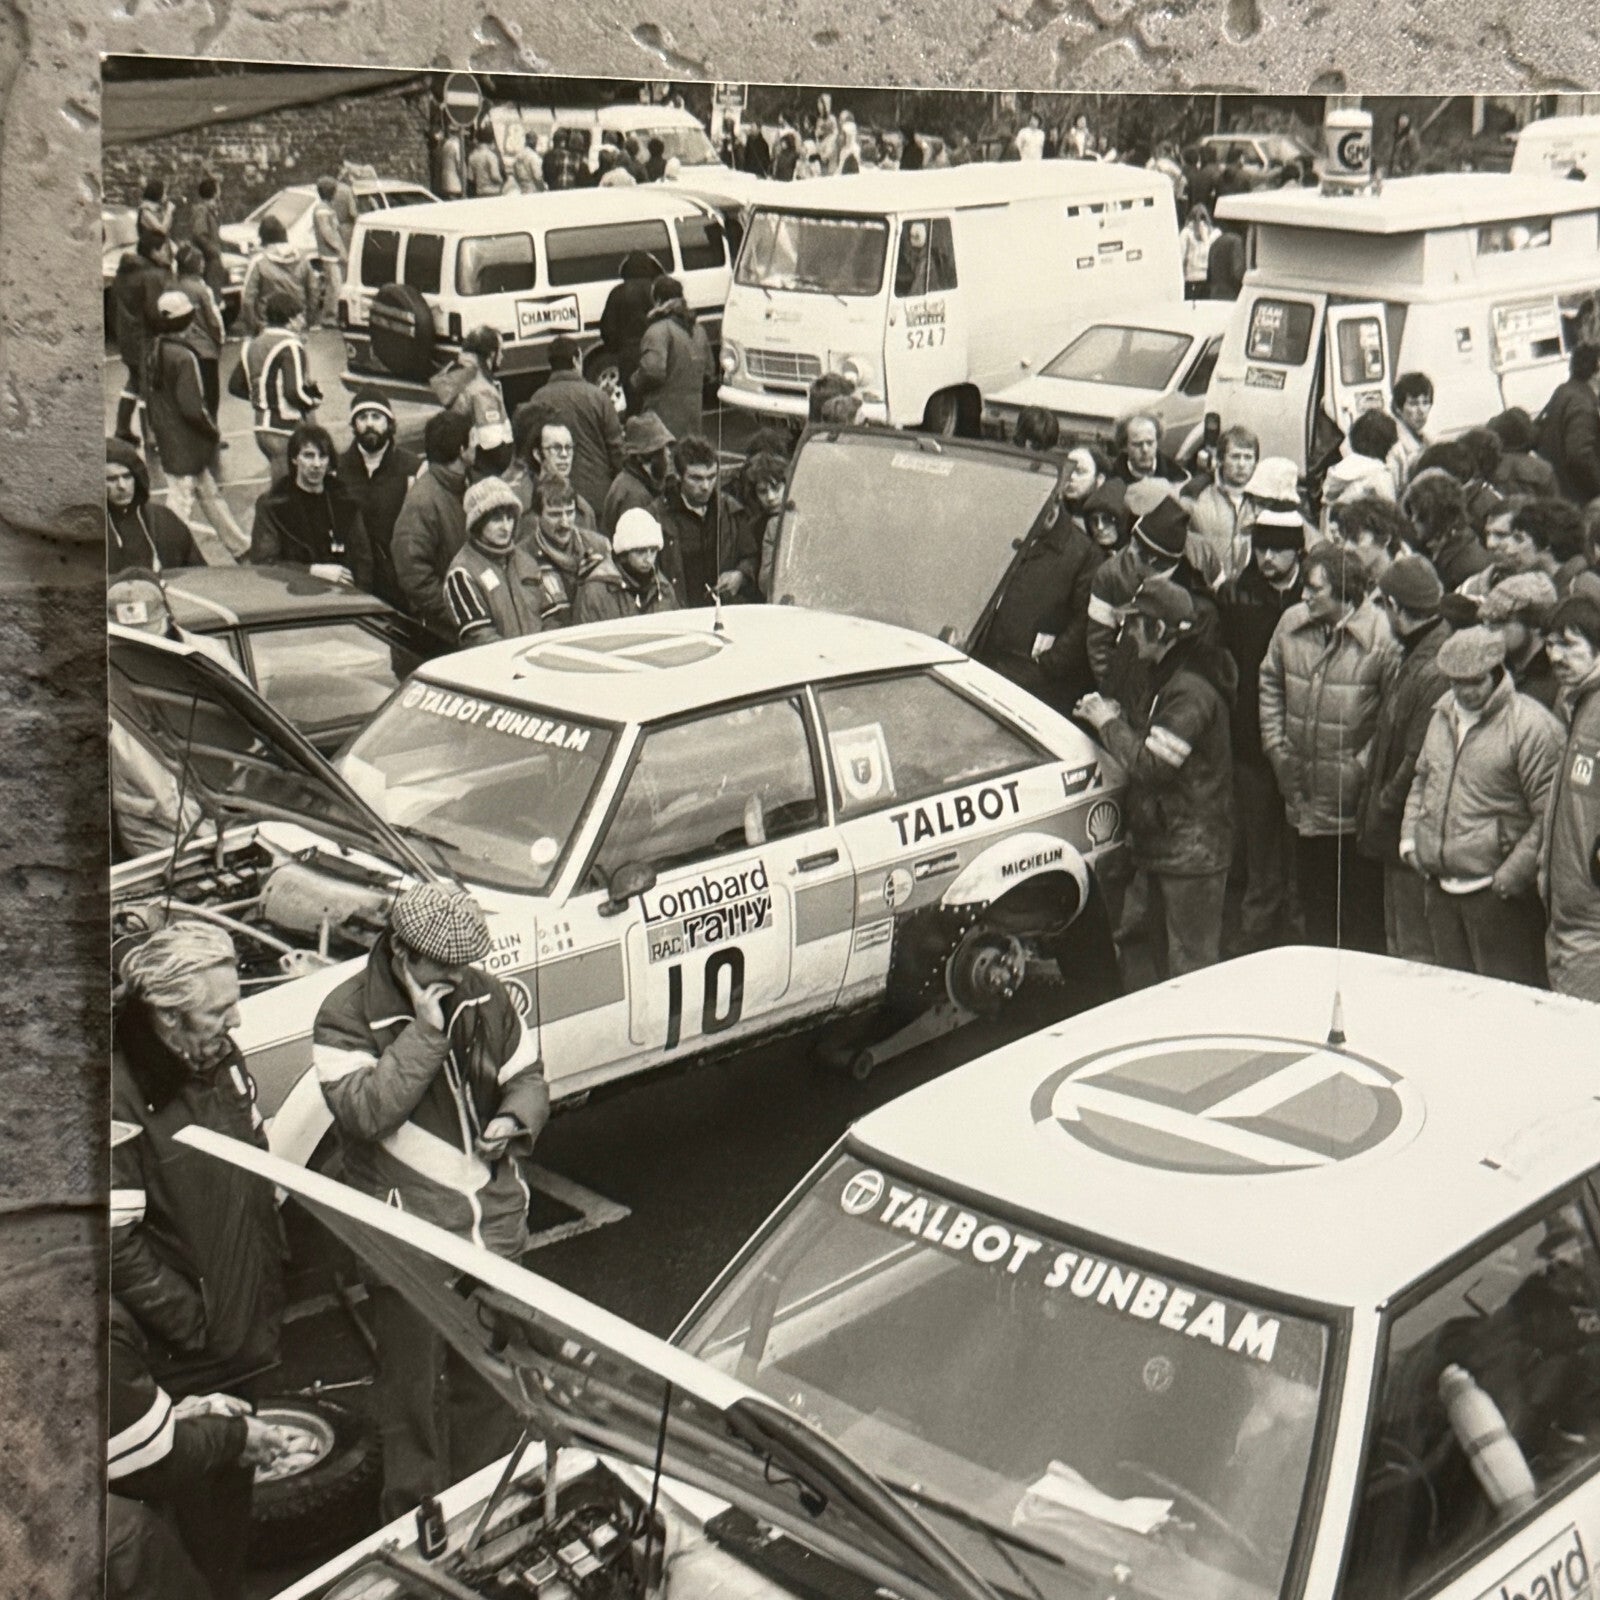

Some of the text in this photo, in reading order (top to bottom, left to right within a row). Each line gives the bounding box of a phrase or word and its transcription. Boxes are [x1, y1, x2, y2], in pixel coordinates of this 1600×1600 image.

[521, 307, 576, 326] CHAMPION
[419, 690, 491, 724] TALBOT
[486, 709, 591, 752] SUNBEAM
[889, 780, 1020, 846] TALBOT
[640, 860, 769, 923] Lombard
[1001, 847, 1063, 878] MICHELIN
[652, 896, 770, 960] RAC rally
[664, 946, 745, 1052] 10
[879, 1186, 1043, 1274] TALBOT
[1044, 1252, 1280, 1362] SUNBEAM
